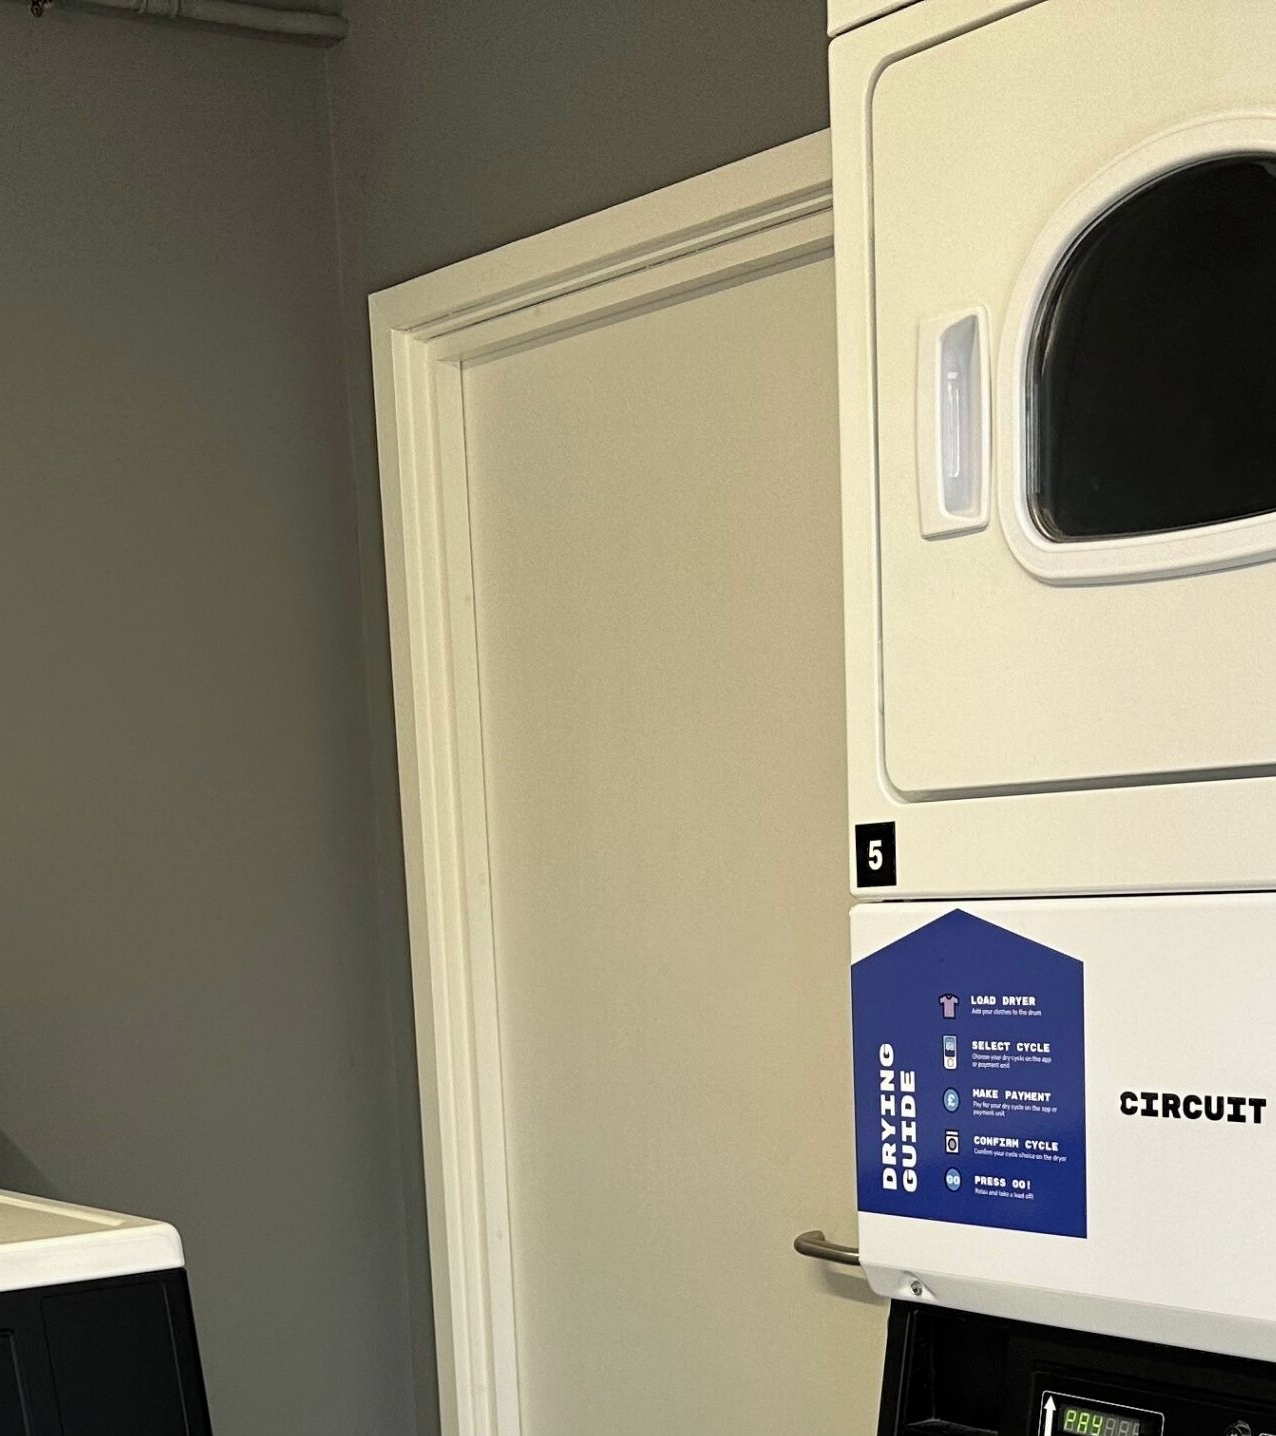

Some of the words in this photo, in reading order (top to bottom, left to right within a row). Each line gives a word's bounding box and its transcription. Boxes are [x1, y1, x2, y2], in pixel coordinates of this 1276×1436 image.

[868, 840, 883, 871] 5
[970, 995, 996, 1005] LOAD
[1002, 996, 1035, 1006] DRYER
[971, 1040, 1010, 1051] SELECT
[1016, 1042, 1050, 1053] CYCLE
[972, 1088, 998, 1099] MAKE
[1004, 1090, 1051, 1101] PAYMENT
[1120, 1091, 1267, 1124] CIRCUIT
[879, 1043, 898, 1190] DRYING
[900, 1070, 918, 1193] GUIDE
[973, 1135, 1019, 1148] CONFIRM
[1024, 1139, 1058, 1151] CYCLE
[946, 1174, 960, 1186] GO
[974, 1175, 1006, 1187] PRESS
[1064, 1410, 1103, 1436] PAY
